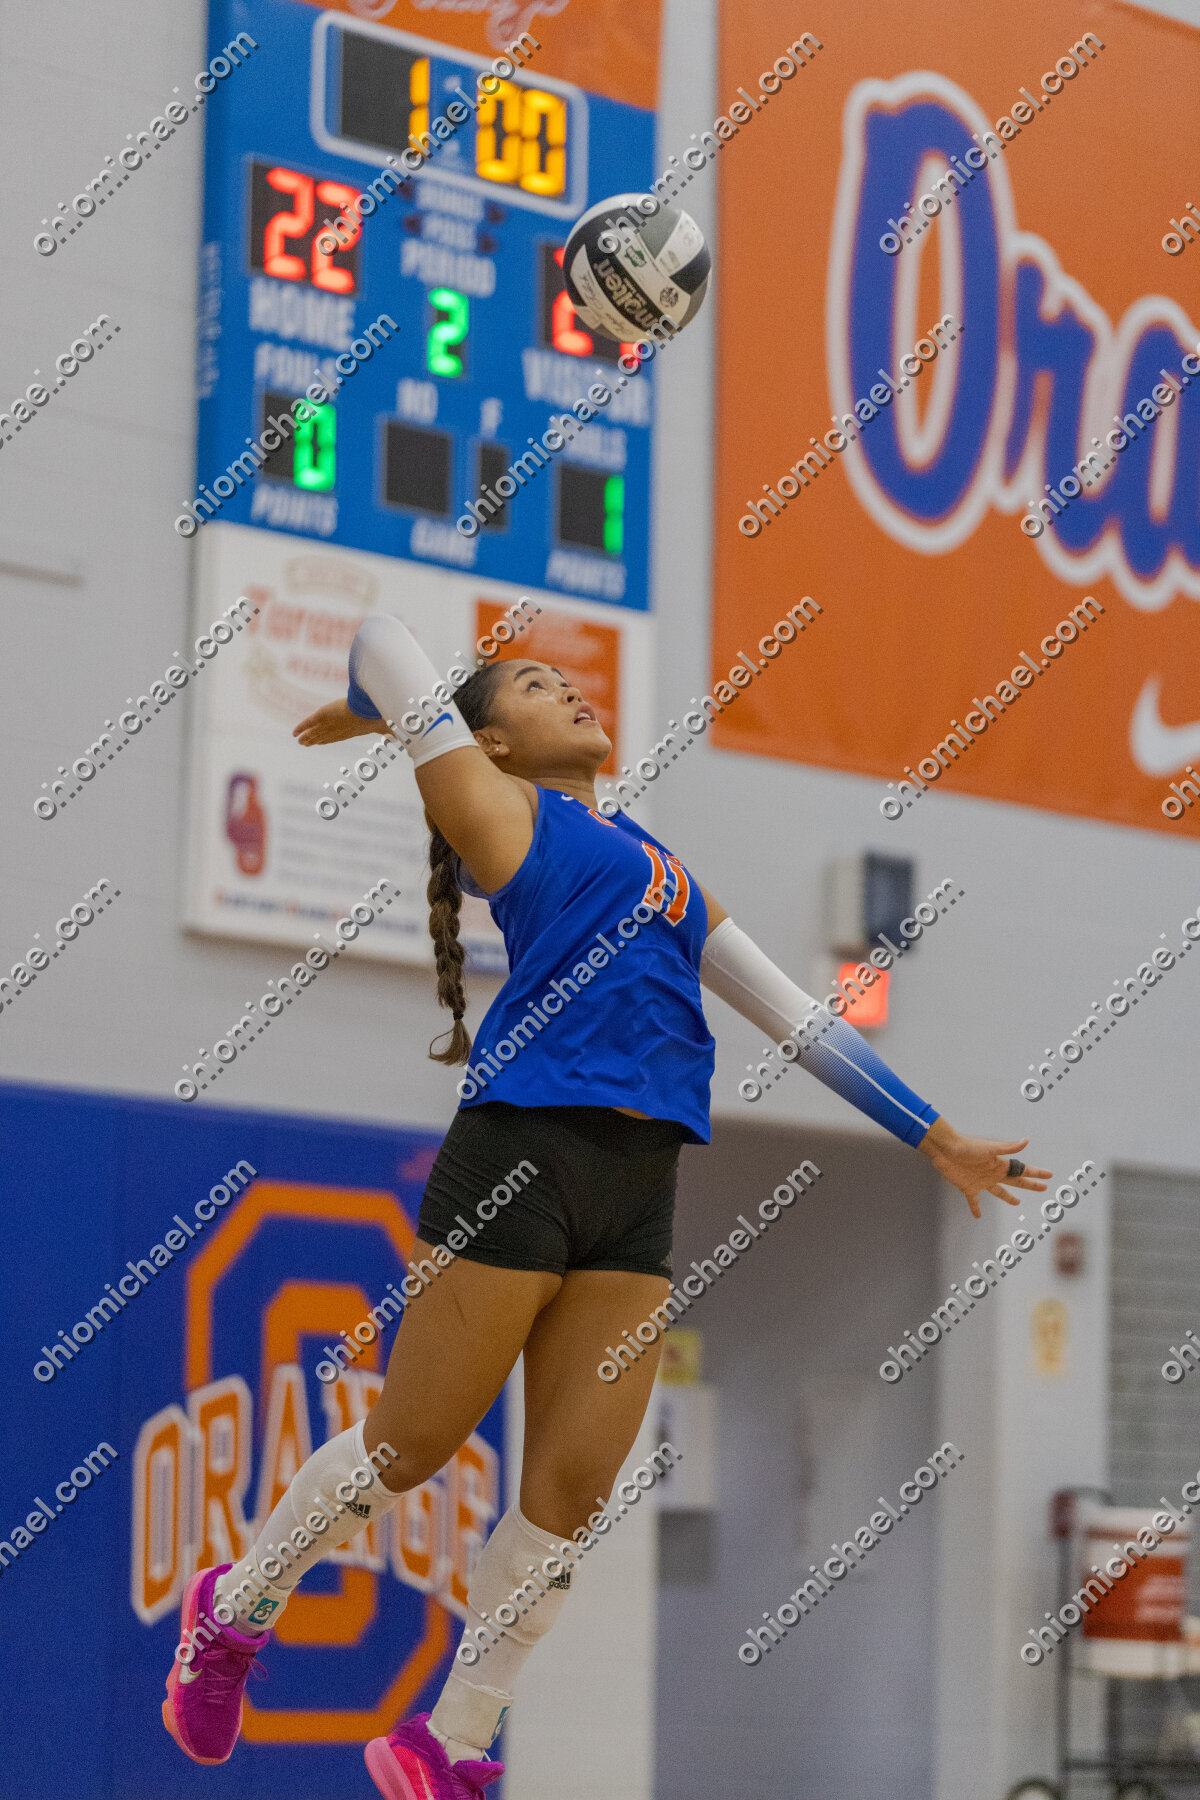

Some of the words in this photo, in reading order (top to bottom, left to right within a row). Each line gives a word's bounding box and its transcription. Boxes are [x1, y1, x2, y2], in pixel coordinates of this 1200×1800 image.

[264, 167, 361, 295] 22
[427, 287, 470, 379] 2
[594, 258, 660, 329] molten
[292, 397, 337, 492] 0
[603, 475, 625, 555] 1
